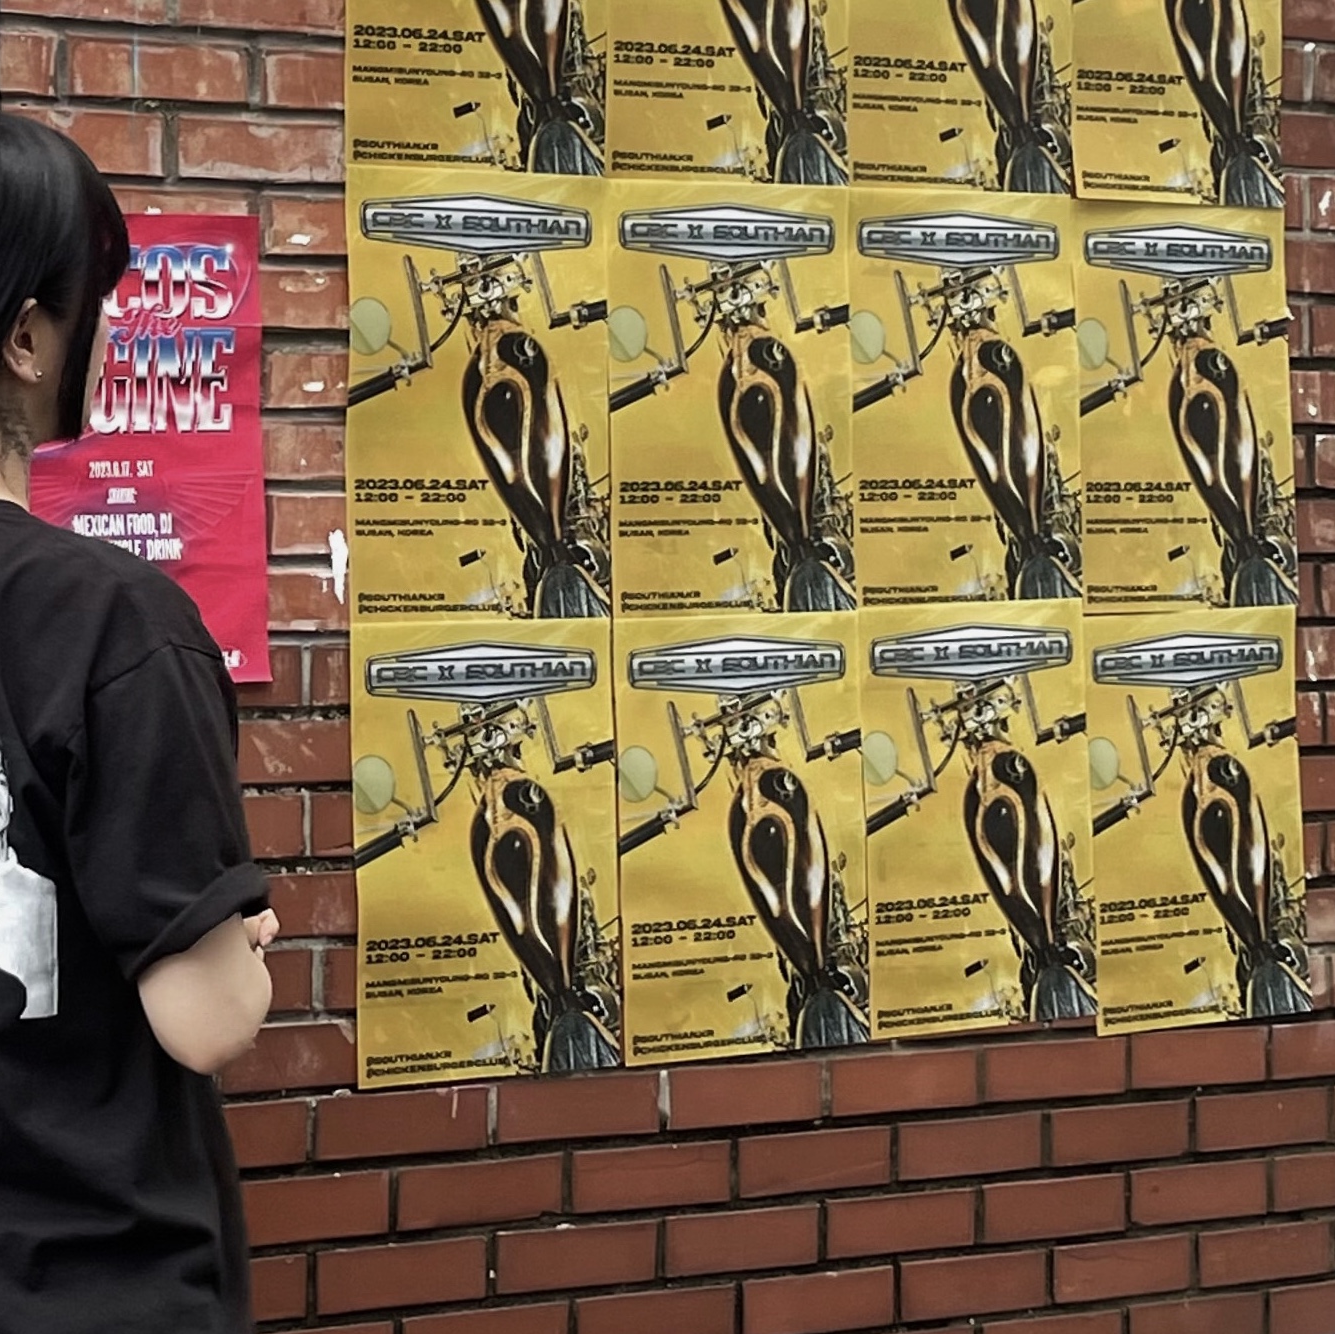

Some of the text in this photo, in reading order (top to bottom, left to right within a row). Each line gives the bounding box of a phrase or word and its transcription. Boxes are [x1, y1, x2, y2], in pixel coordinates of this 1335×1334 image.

[353, 39, 463, 54] 12:00 22:00
[137, 460, 154, 478] SAT
[354, 492, 466, 503] 12:00 22:00
[71, 513, 173, 538] MEXICAN FOOD, DJ
[146, 538, 184, 561] DRINK
[366, 948, 477, 964] 12:00 22:00
